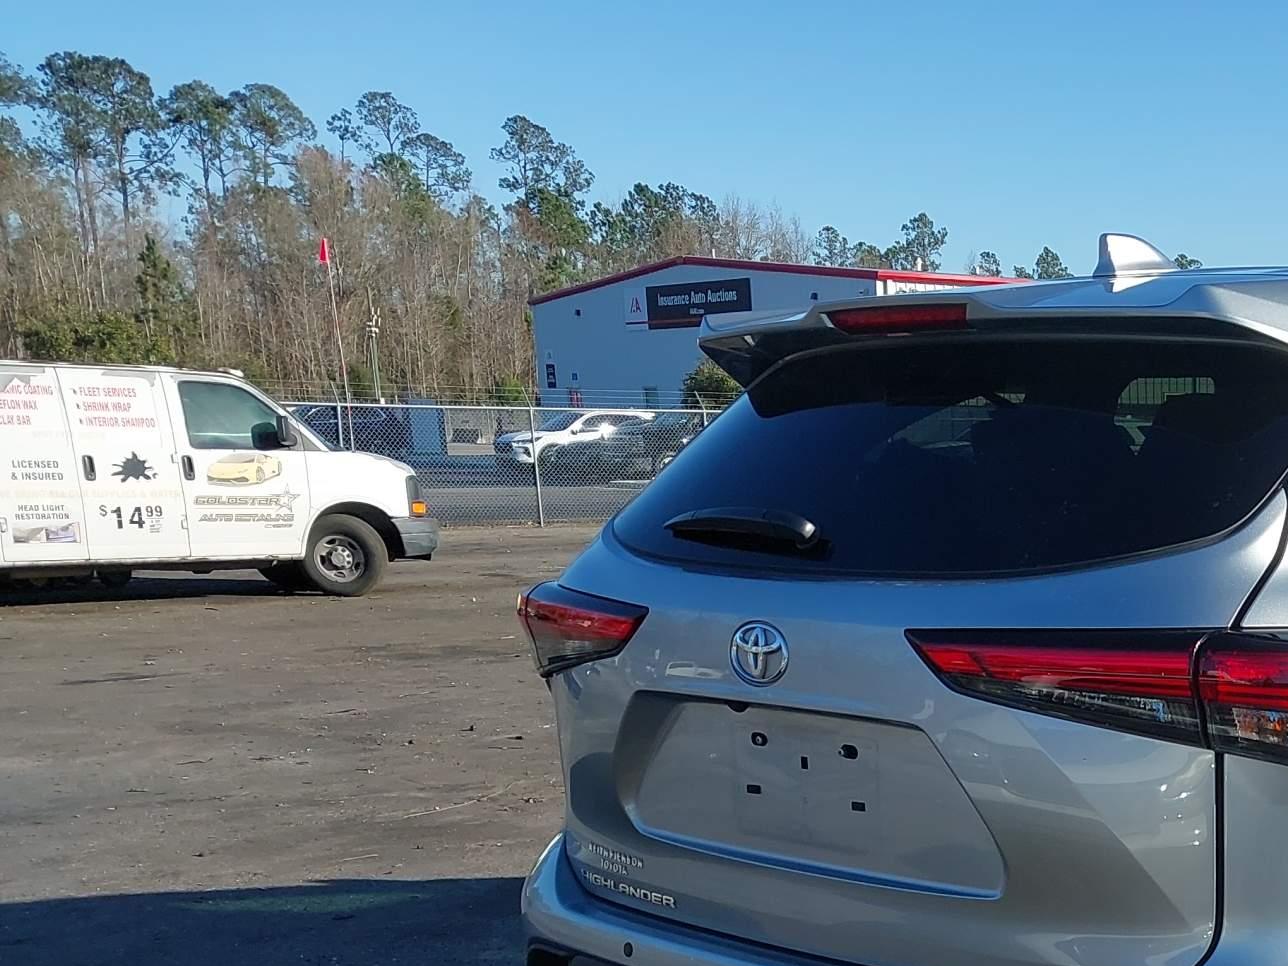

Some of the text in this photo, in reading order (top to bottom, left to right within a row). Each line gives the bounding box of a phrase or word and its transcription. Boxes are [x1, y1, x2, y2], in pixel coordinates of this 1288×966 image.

[657, 288, 737, 306] Insurance Auto Auctions
[24, 384, 53, 396] COATING
[79, 387, 137, 398] FLEET SERVICES
[22, 400, 38, 411] WAX
[83, 401, 132, 412] SHRINK WRAP
[16, 415, 32, 425] BAR
[85, 416, 156, 429] INTERIOR SHAMPOO
[11, 460, 59, 469] LICENSED
[11, 472, 64, 481] & INSURED
[17, 504, 65, 512] HEAD LIGHT
[15, 512, 70, 521] RESTORATION
[600, 859, 628, 876] TOYOTA
[580, 867, 677, 909] HIGHLANDER
